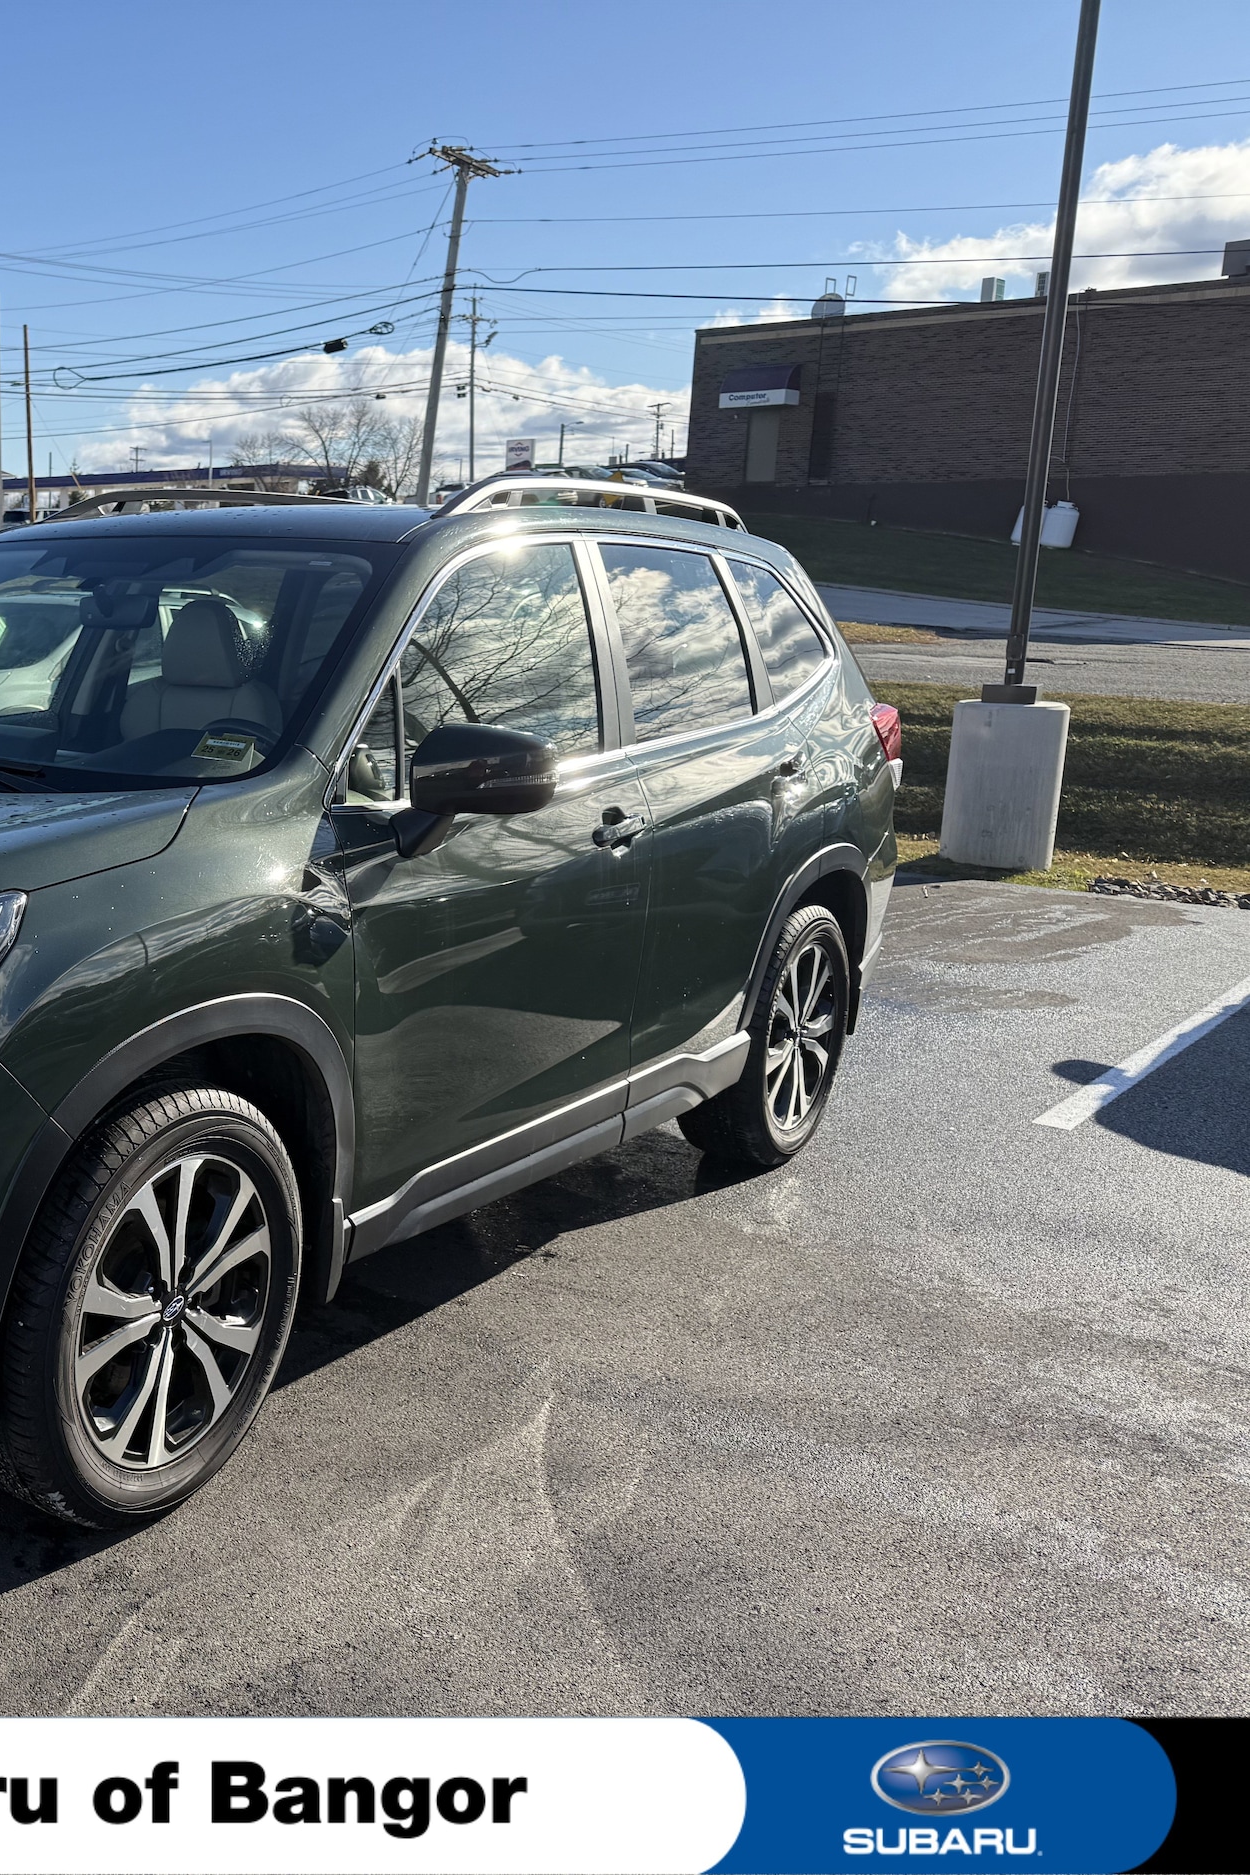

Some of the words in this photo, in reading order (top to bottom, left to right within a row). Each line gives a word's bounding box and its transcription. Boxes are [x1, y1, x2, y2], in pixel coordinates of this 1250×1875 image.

[729, 392, 767, 402] Computer
[201, 745, 214, 753] 25
[226, 749, 241, 757] 26
[63, 1180, 132, 1308] YOKOHAMA
